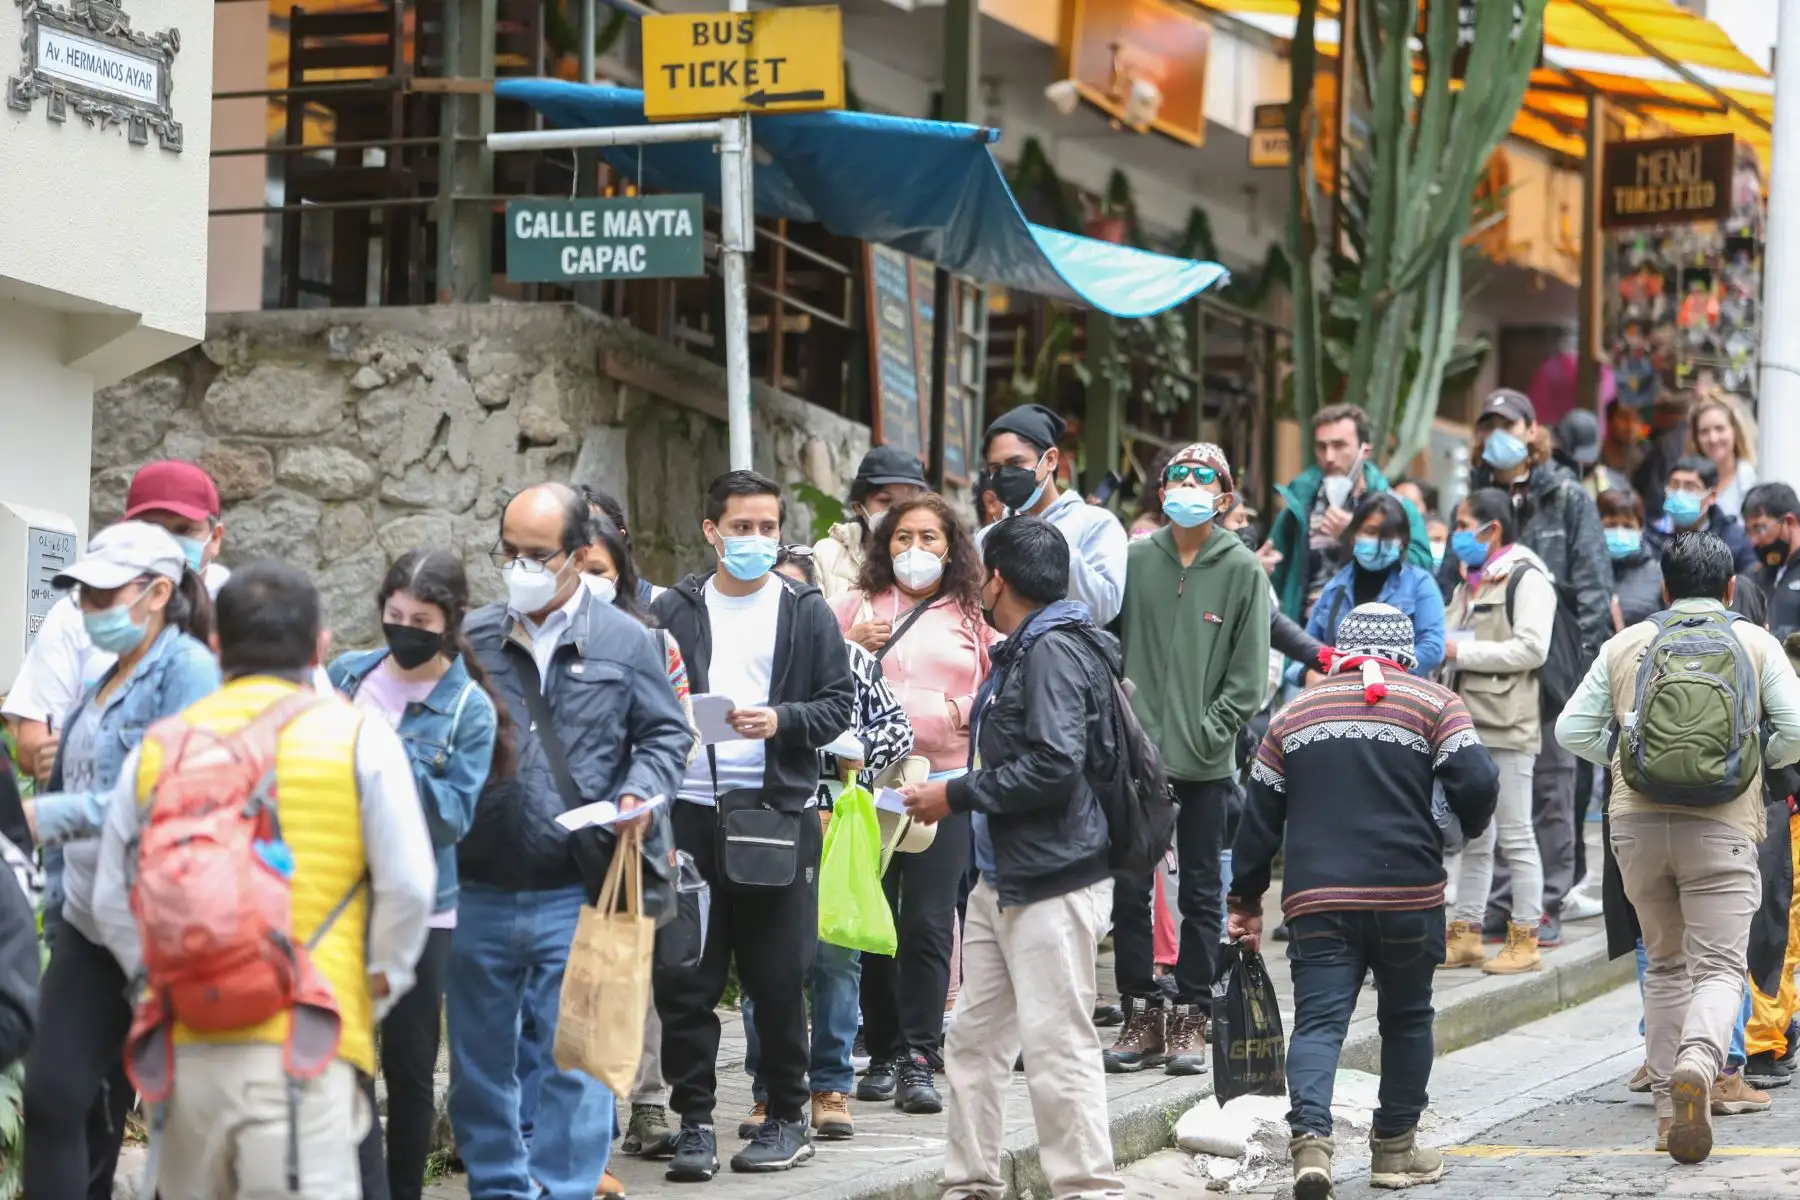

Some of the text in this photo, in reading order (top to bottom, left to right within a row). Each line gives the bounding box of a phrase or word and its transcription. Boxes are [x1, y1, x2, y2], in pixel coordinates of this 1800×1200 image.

[691, 19, 755, 47] BUS
[45, 41, 153, 91] Av. HERMANOS AYAR
[660, 57, 787, 90] TICKET
[515, 208, 694, 239] CALLE MAYTA
[560, 244, 647, 275] CAPAC
